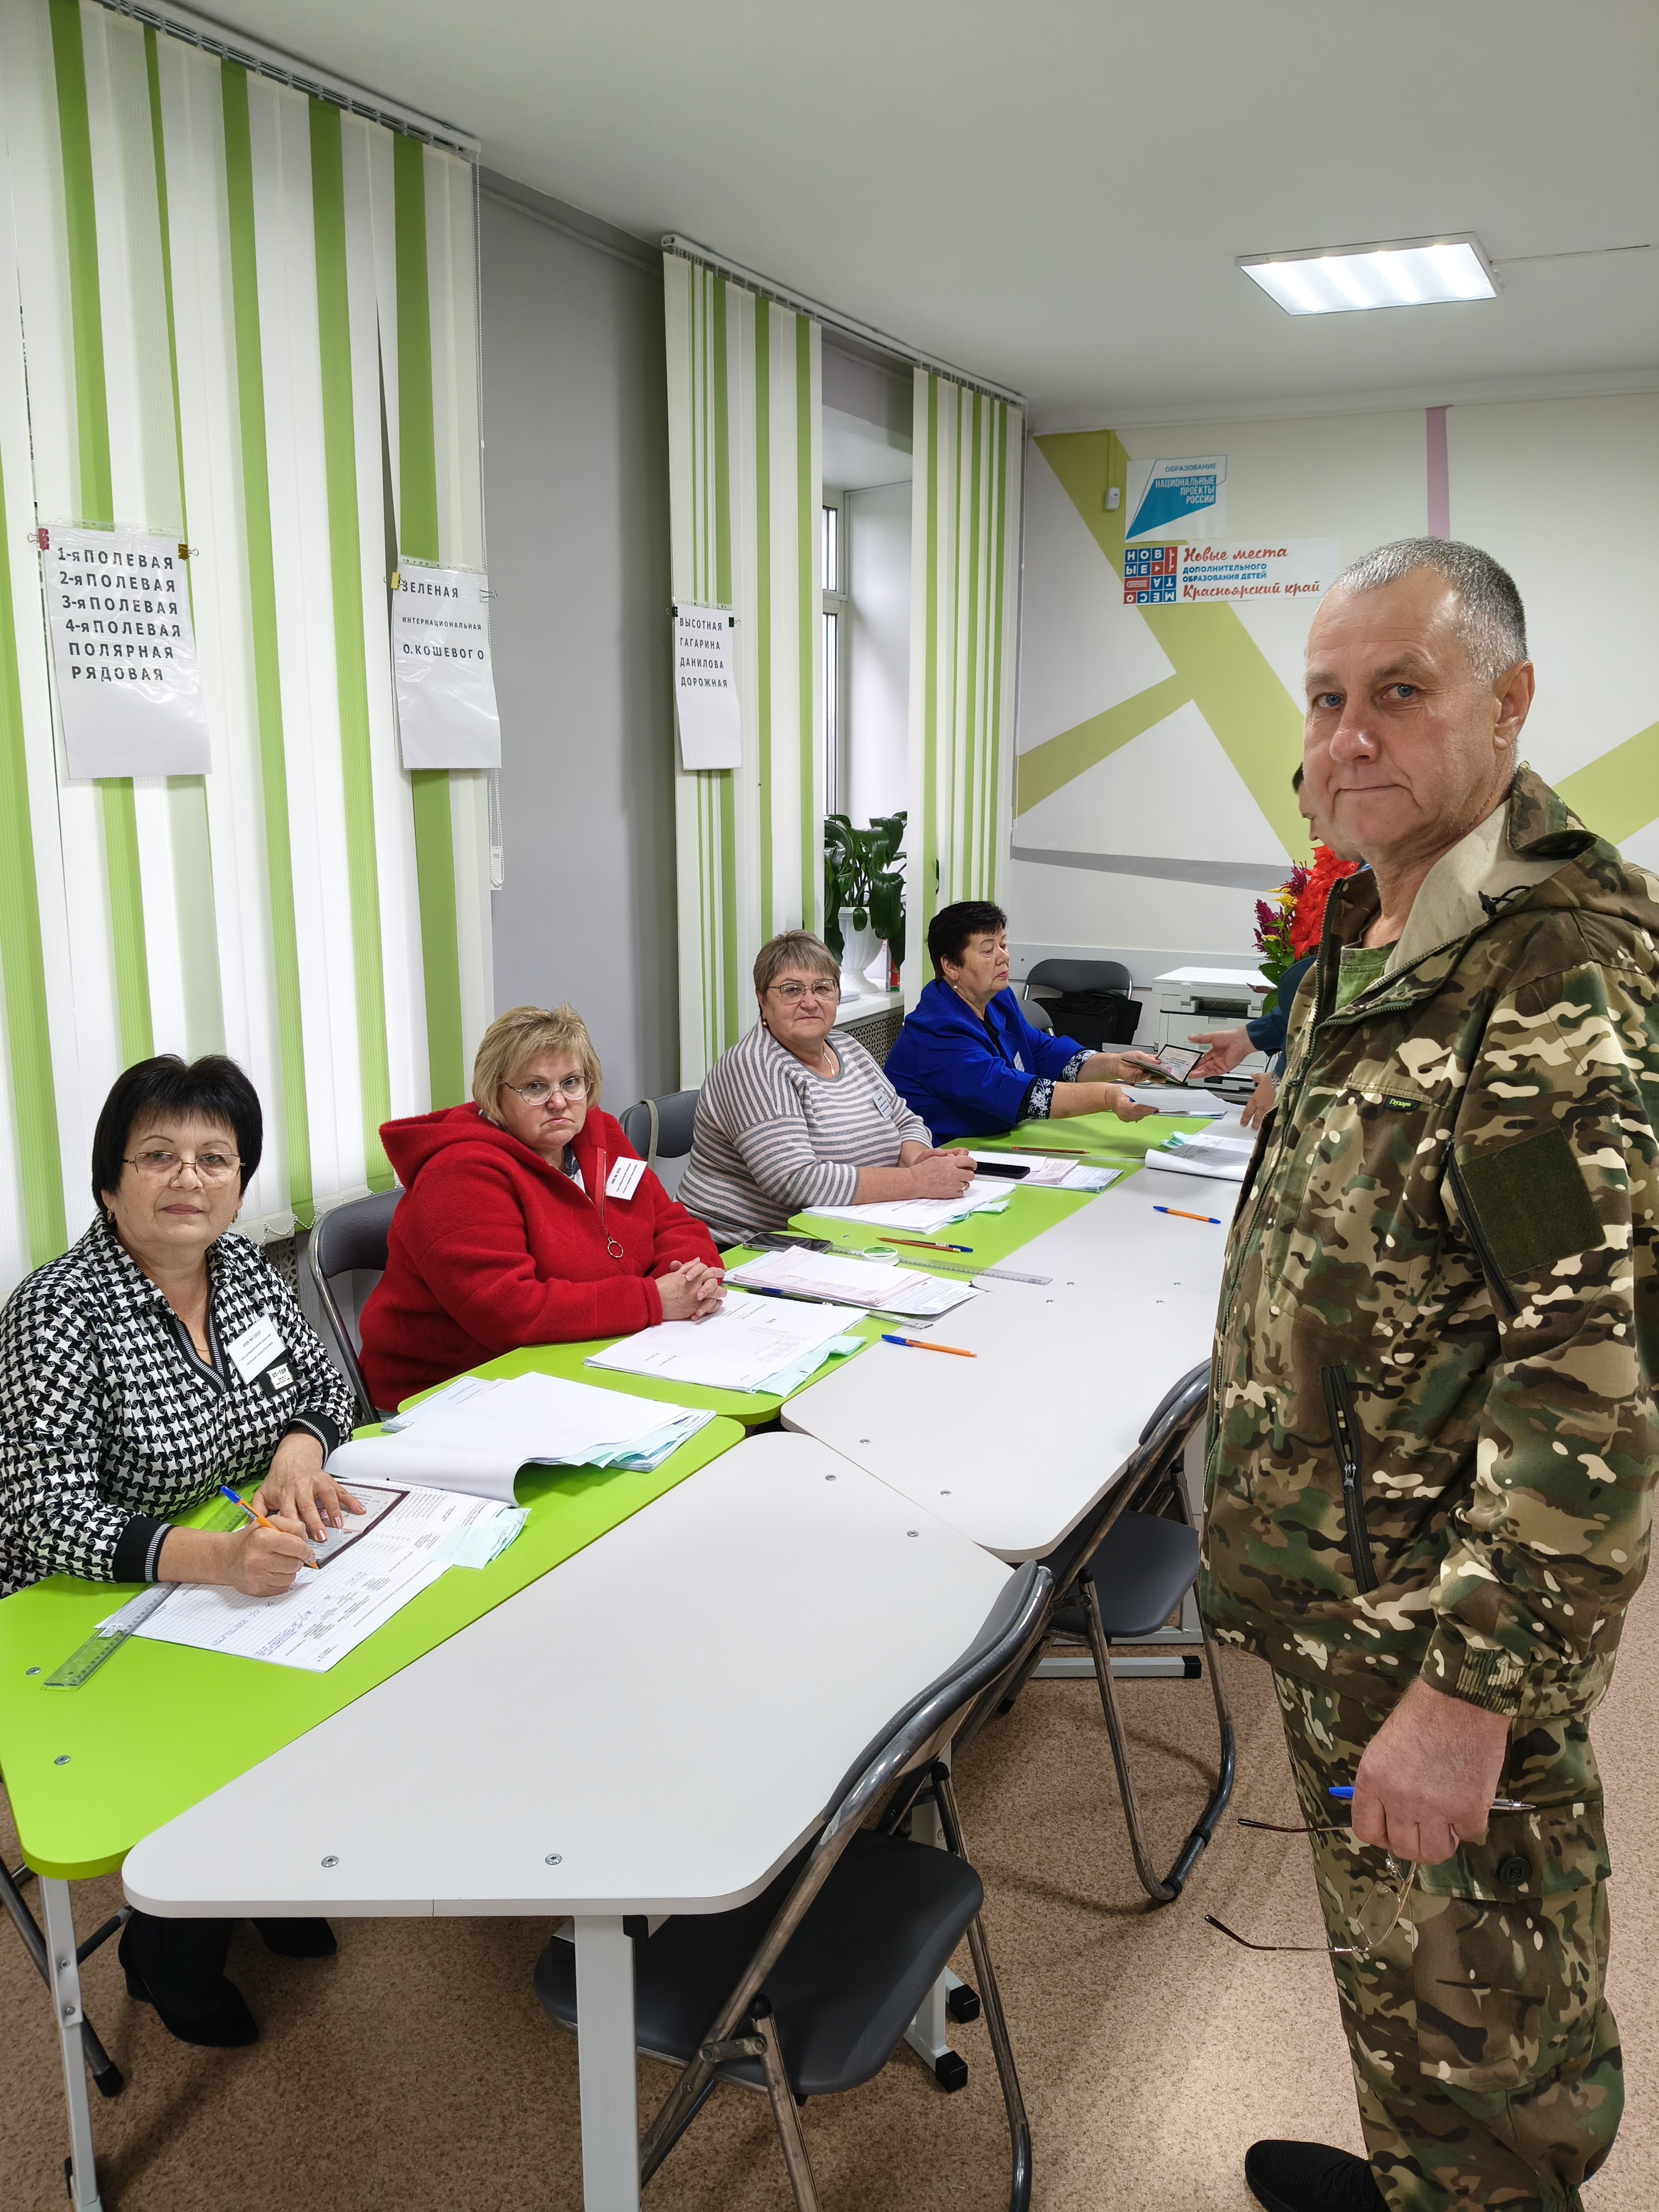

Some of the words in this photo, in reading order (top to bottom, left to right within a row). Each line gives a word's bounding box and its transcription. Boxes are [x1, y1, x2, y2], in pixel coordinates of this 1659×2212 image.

[1165, 463, 1217, 473] ОБРАЗОВАНИЕ
[1155, 476, 1215, 488] НАЦИОНАЛЬНЫЕ
[1180, 485, 1215, 496] ПРОЕКТЫ
[1186, 494, 1215, 504] РОССИИ
[58, 547, 80, 562] 1-я
[84, 550, 173, 570] ПОЛЕВАЯ
[1183, 547, 1228, 563] Новые
[1232, 548, 1289, 560] места
[1183, 563, 1267, 575] ДОПОЛНИТЕЛЬНОГО
[60, 571, 83, 586] 2-я
[86, 574, 175, 592] ПОЛЕВАЯ
[1183, 574, 1239, 582] ОБРАЗОВАНИЯ
[1240, 571, 1267, 579] ДЕТЕЙ
[402, 580, 458, 598] ЗЕЛЕНАЯ
[1183, 583, 1281, 601] Красноярский
[1285, 581, 1321, 596] край
[62, 595, 86, 609] 3-я
[90, 597, 178, 615] ПОЛЕВАЯ
[65, 619, 89, 632] 4-я
[93, 621, 180, 637] ПОЛЕВАЯ
[402, 617, 481, 630] ИНТЕРНАЦИОНАЛЬНАЯ
[680, 618, 722, 631] ВЫСОТНАЯ
[69, 642, 173, 659] ПОЛЯРНАЯ
[680, 638, 720, 650] ГАГАРИНА
[680, 657, 724, 669] ДАНИЛОВА
[72, 666, 163, 682] РЯДОВАЯ
[681, 677, 727, 687] ДОРОЖНАЯ
[272, 1368, 287, 1378] UT-TOP
